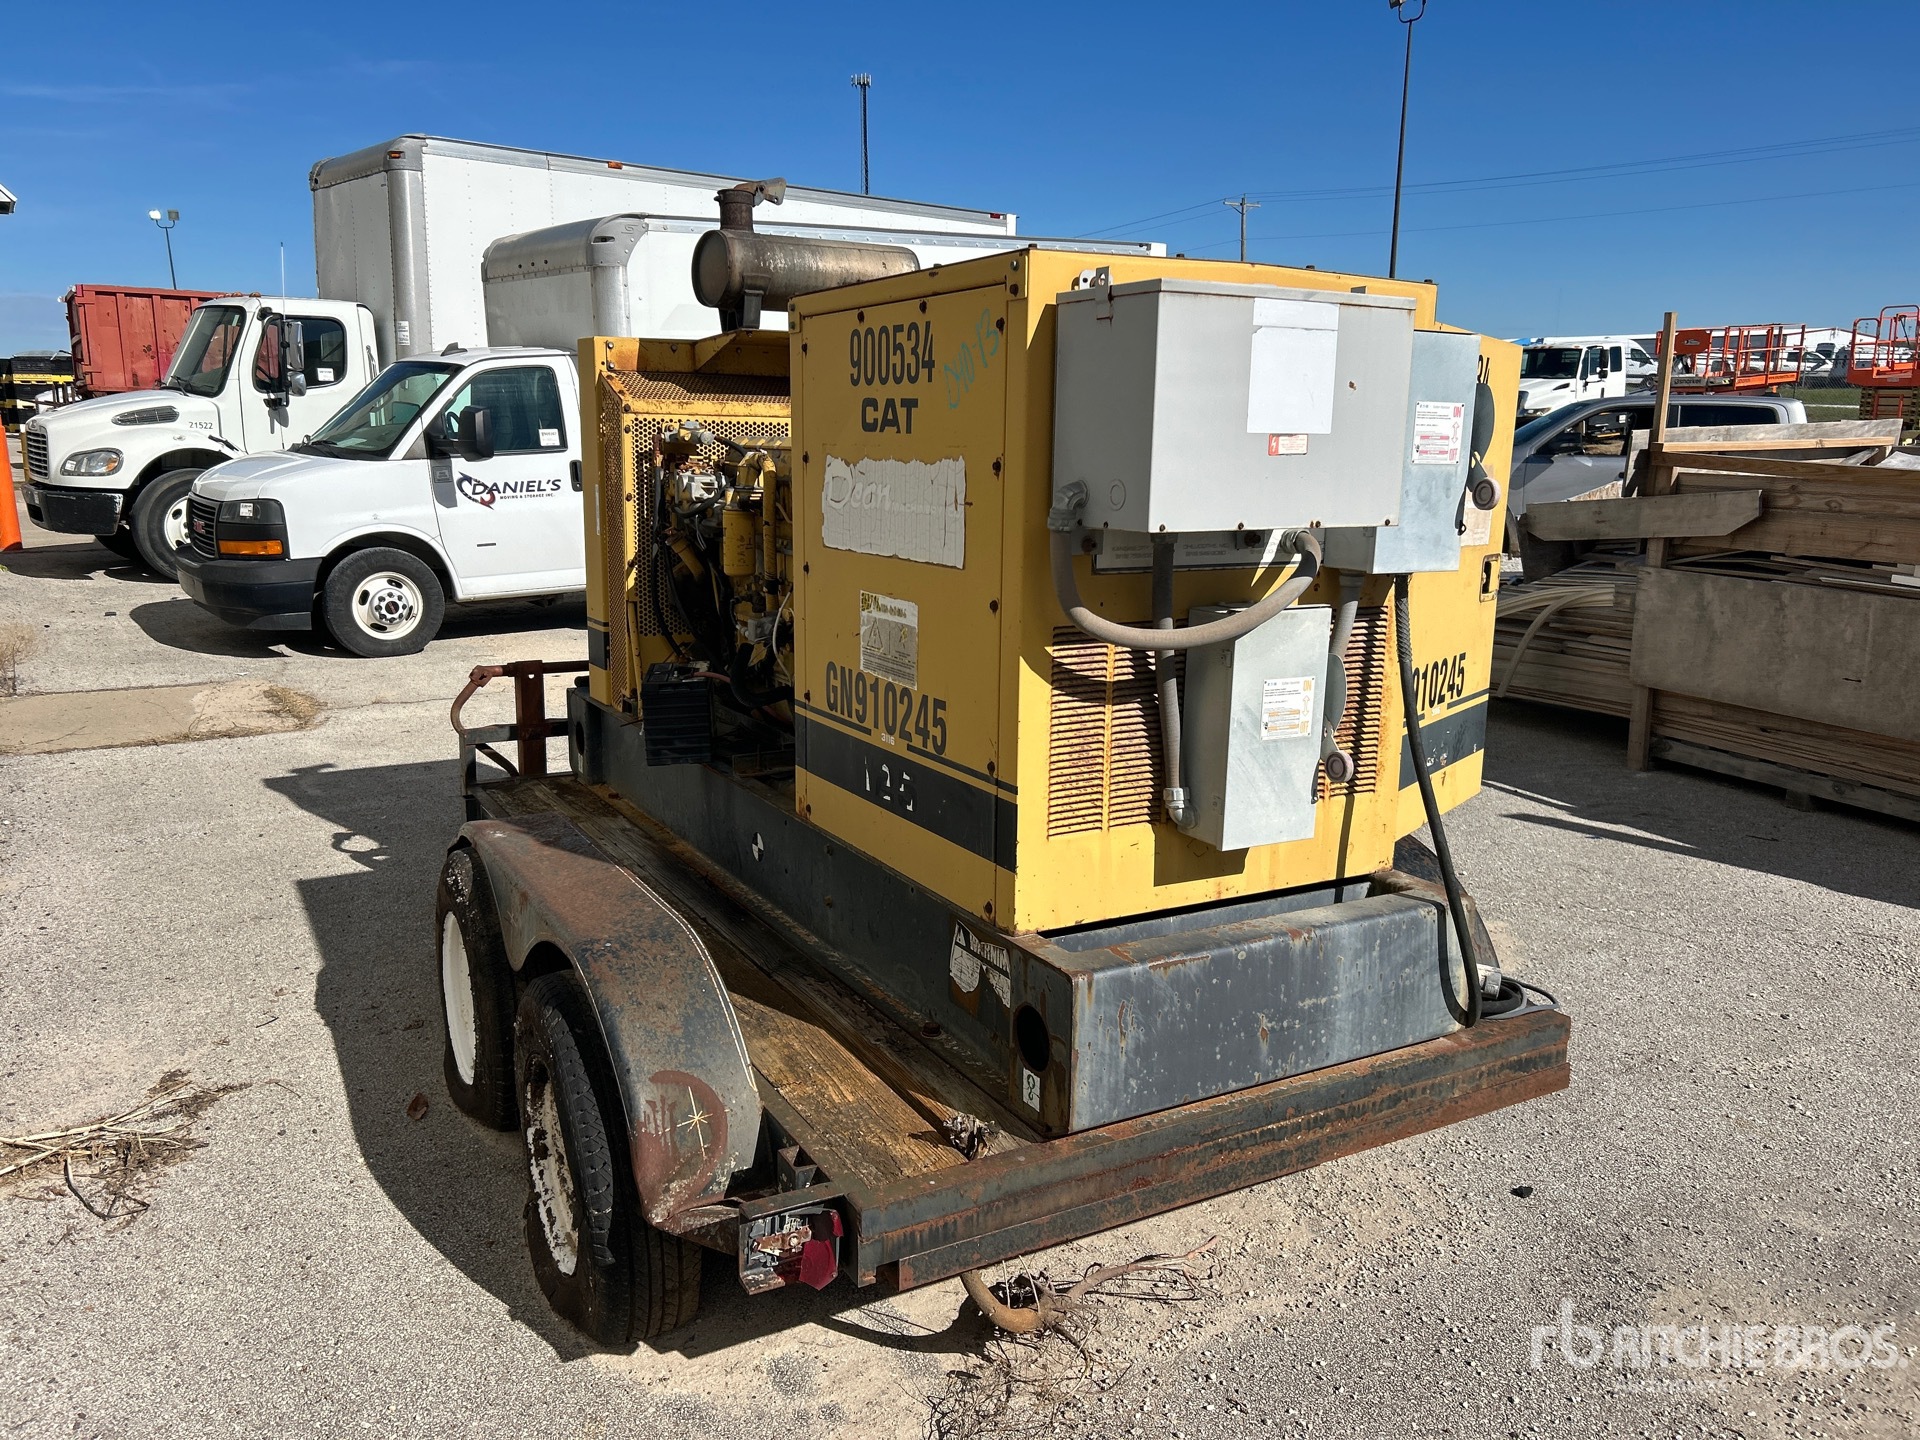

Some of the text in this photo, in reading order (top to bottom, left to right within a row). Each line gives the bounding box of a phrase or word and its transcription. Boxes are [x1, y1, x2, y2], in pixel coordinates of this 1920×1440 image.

[849, 320, 936, 387] 900534
[188, 421, 214, 429] 21522
[860, 397, 919, 434] CAT
[471, 478, 562, 495] DANIEL'S
[825, 660, 948, 756] GN910245
